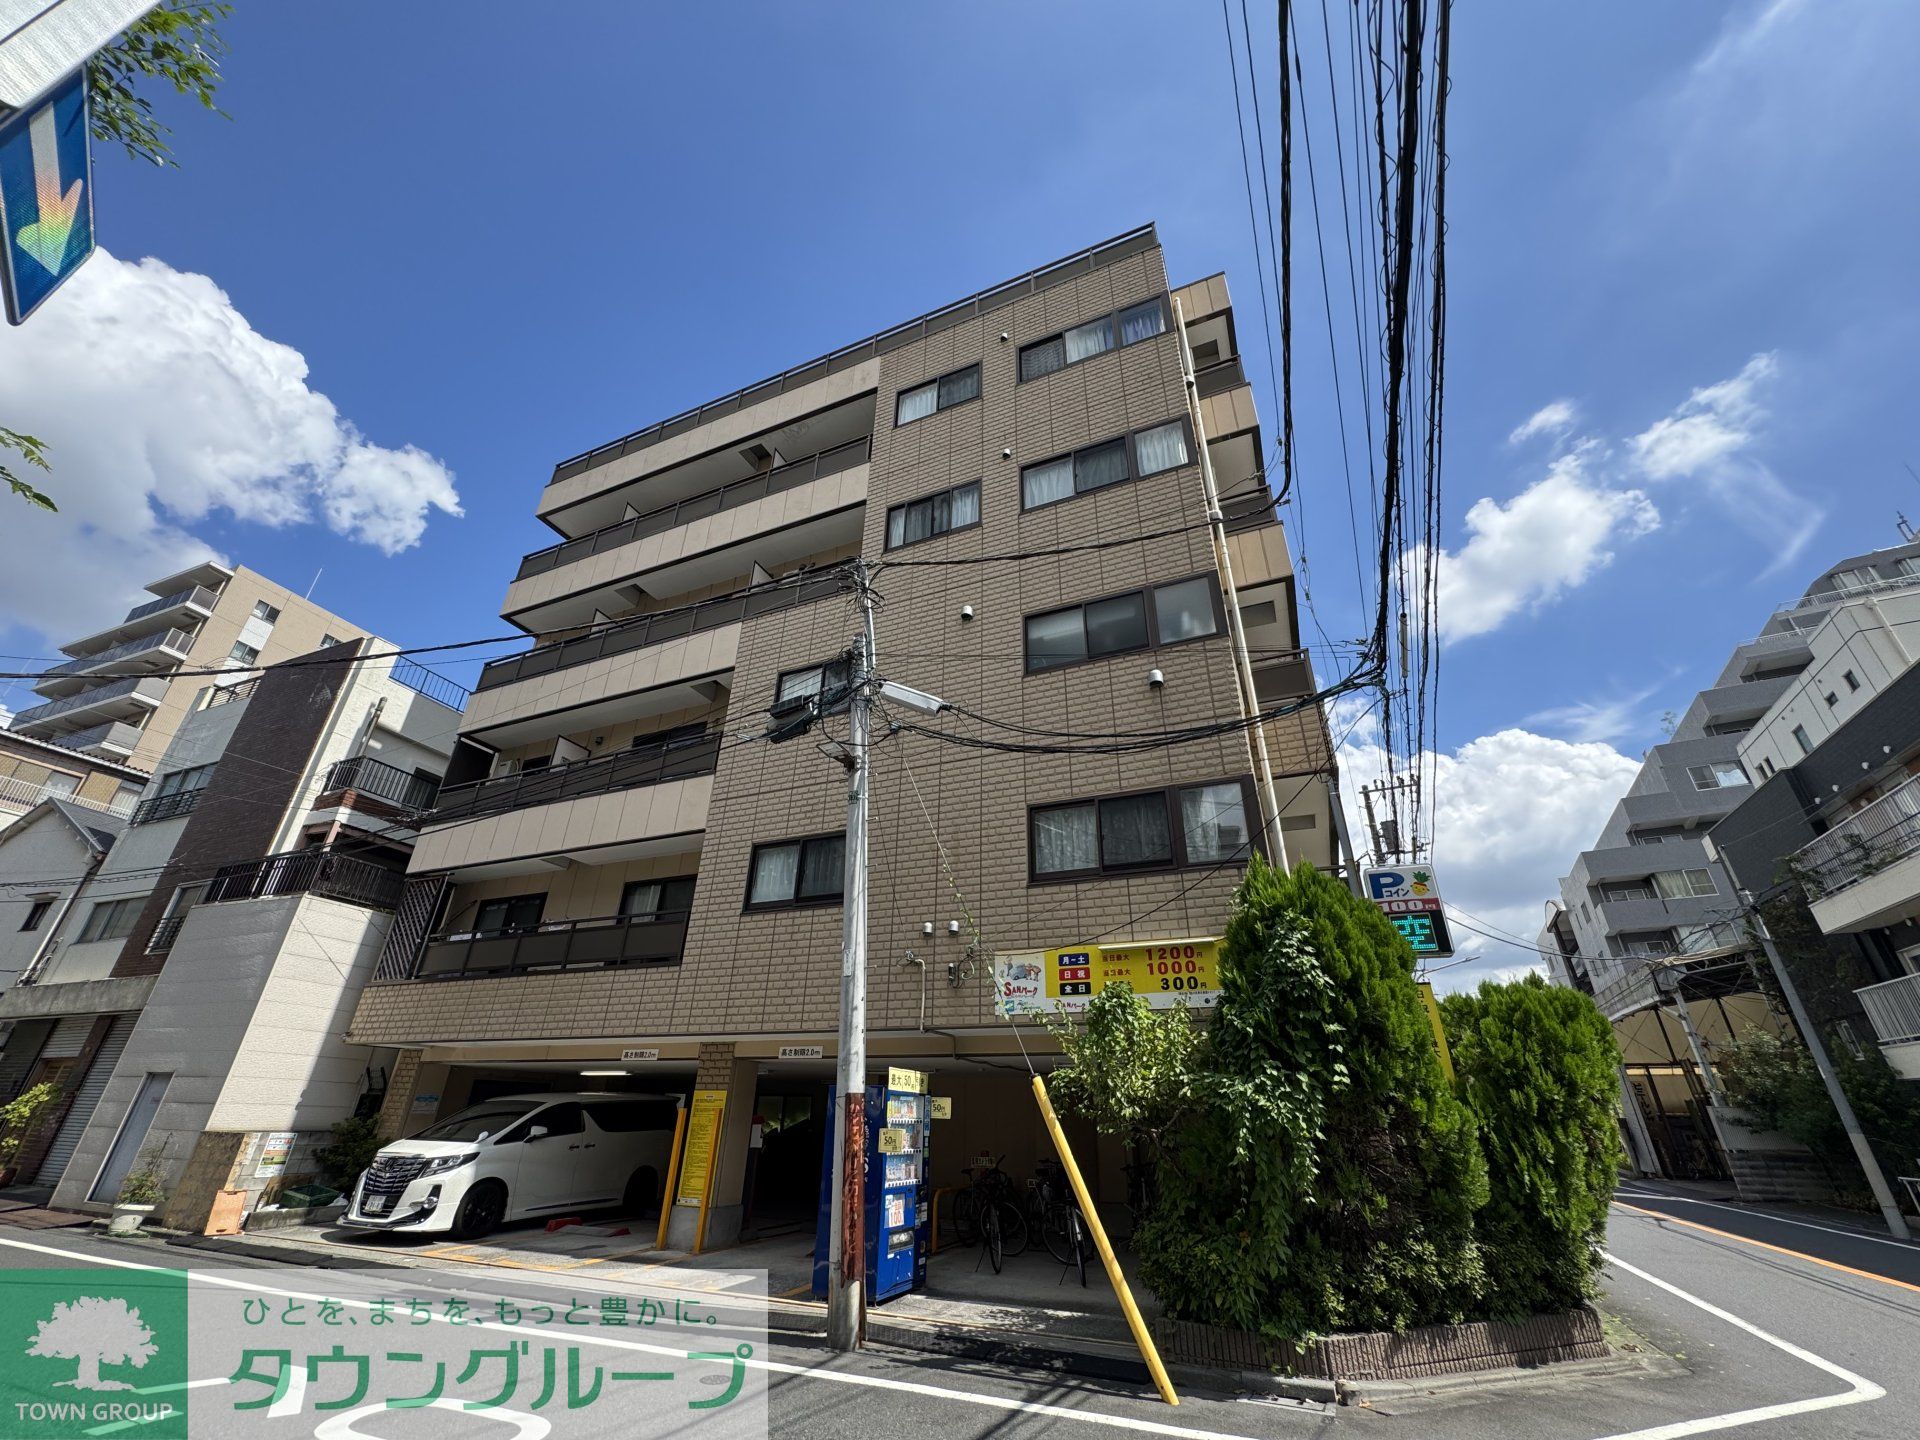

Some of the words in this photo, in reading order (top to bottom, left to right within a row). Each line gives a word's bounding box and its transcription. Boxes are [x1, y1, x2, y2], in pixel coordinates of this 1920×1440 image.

[1368, 872, 1405, 899] P
[1384, 887, 1410, 898] コイン
[1391, 915, 1437, 950] 空
[1064, 984, 1086, 993] 全日
